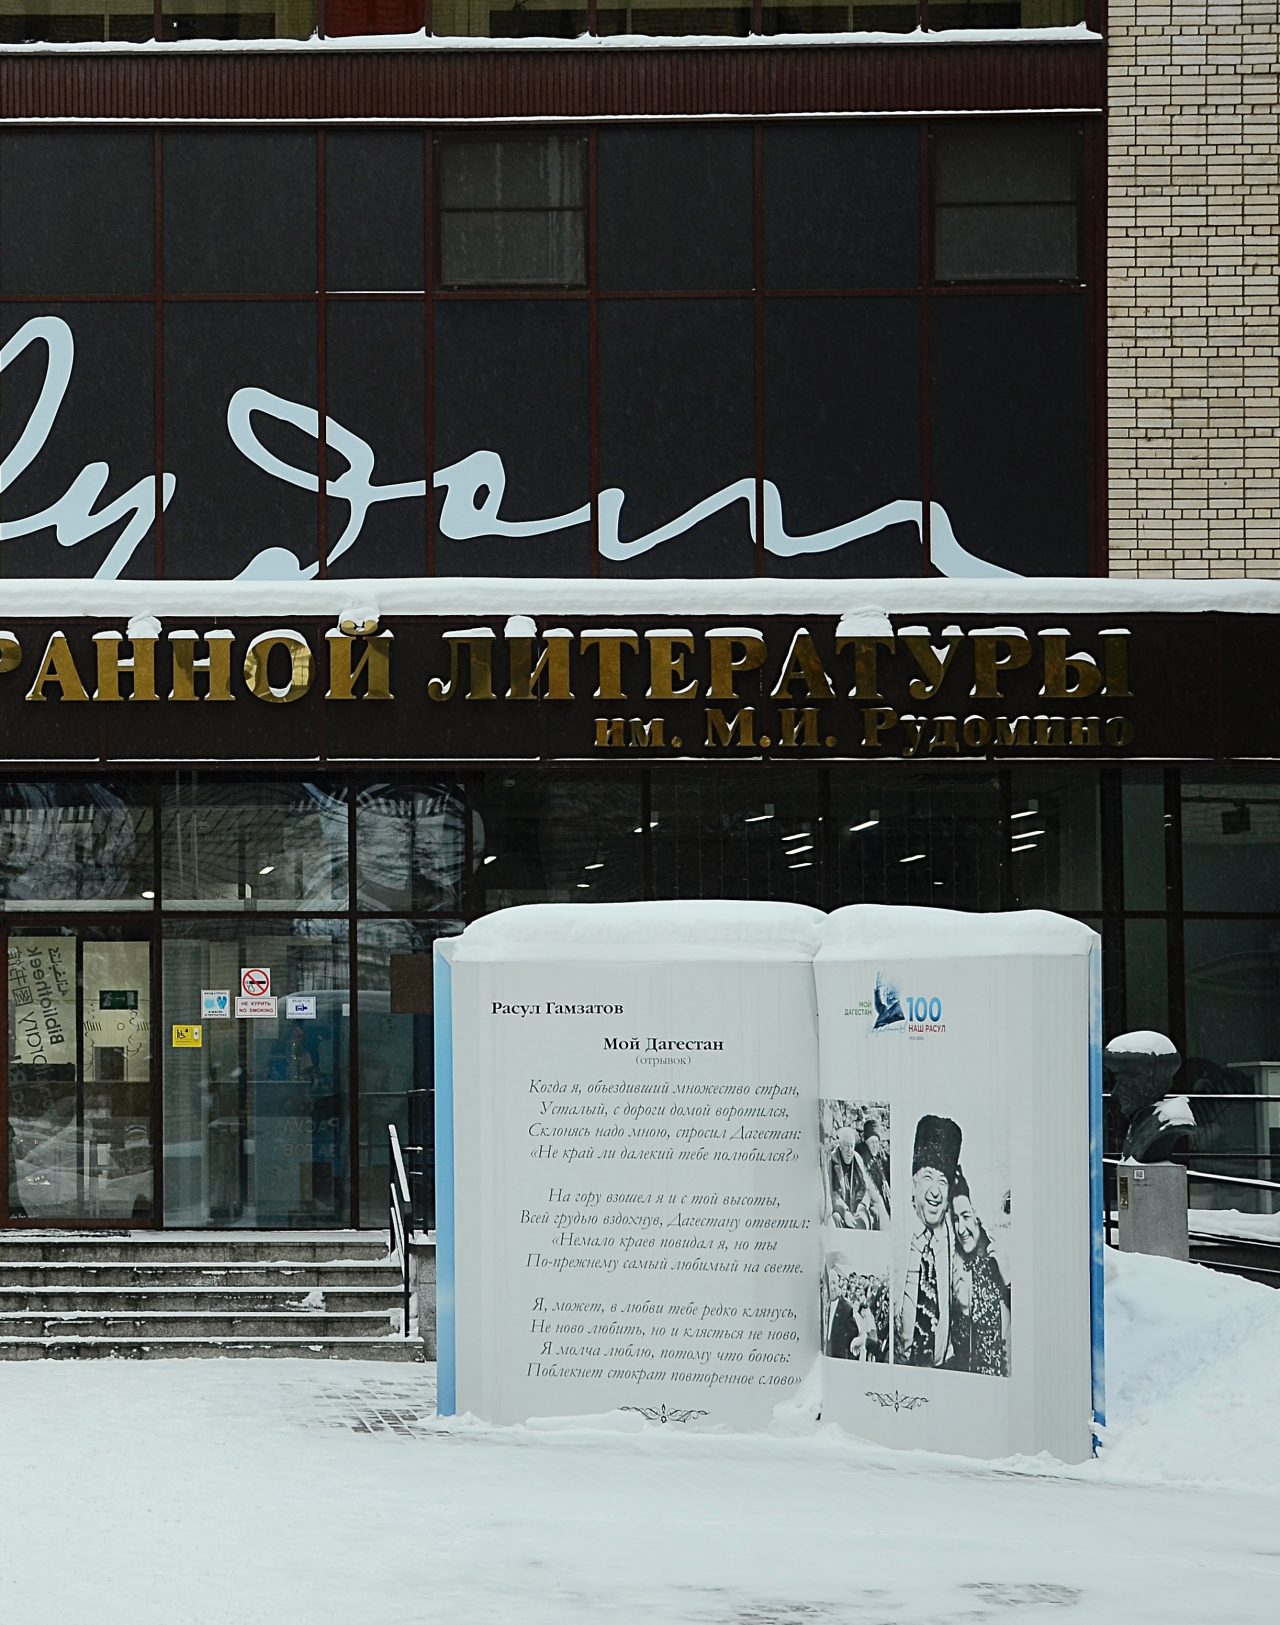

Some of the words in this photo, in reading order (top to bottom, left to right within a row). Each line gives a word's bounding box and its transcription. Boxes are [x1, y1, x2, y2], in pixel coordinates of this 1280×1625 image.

[428, 629, 1133, 701] ЛИТЕРАТУРЫ
[595, 717, 683, 748] им.
[703, 707, 838, 748] М.И.
[860, 708, 1136, 755] Рудомино
[491, 1002, 540, 1018] Расул
[546, 1002, 623, 1014] Гамзатов
[844, 1008, 872, 1016] ДАГЕСТАН
[906, 996, 942, 1022] 100
[908, 1025, 924, 1033] НАШ
[926, 1025, 946, 1033] РАСУЛ
[603, 1037, 640, 1050] Мой
[645, 1038, 724, 1053] Дагестан
[636, 1056, 691, 1067] (отрывок)
[528, 1079, 567, 1093] Когда
[570, 1083, 582, 1096] я,
[588, 1080, 669, 1094] объездивший
[673, 1085, 750, 1094] множество
[755, 1084, 799, 1099] стран,
[540, 1101, 607, 1117] Усталый,
[613, 1105, 621, 1116] с
[624, 1102, 665, 1120] дороги
[670, 1102, 710, 1116] домой
[716, 1106, 788, 1121] воротился,
[529, 1123, 590, 1136] Склонясь
[595, 1124, 624, 1137] надо
[628, 1128, 670, 1140] мною,
[676, 1127, 726, 1142] спросил
[730, 1125, 801, 1140] Дагестан:
[531, 1145, 558, 1158] «Не
[563, 1147, 594, 1163] край
[596, 1149, 617, 1160] ли
[621, 1146, 674, 1159] далекий
[678, 1147, 708, 1160] тебе
[713, 1148, 799, 1161] полюбился?»
[548, 1187, 571, 1203] На
[575, 1192, 601, 1207] гору
[607, 1194, 651, 1203] взошел
[654, 1193, 665, 1204] я
[667, 1194, 677, 1205] и
[680, 1194, 688, 1205] с
[691, 1193, 718, 1204] той
[723, 1196, 780, 1208] высоты,
[520, 1210, 549, 1223] Всей
[554, 1211, 598, 1228] грудью
[603, 1211, 662, 1229] вздохнув,
[667, 1213, 740, 1232] Дагестану
[745, 1219, 810, 1228] ответил:
[552, 1232, 614, 1246] «Немало
[620, 1236, 655, 1251] краев
[660, 1235, 713, 1249] повидал
[716, 1240, 731, 1253] я,
[733, 1240, 750, 1251] но
[753, 1241, 778, 1251] ты
[527, 1253, 618, 1273] По-прежнему
[623, 1258, 667, 1269] самый
[671, 1258, 738, 1272] любимый
[742, 1263, 760, 1273] на
[764, 1264, 803, 1273] свете.
[531, 1296, 548, 1314] Я,
[552, 1302, 604, 1314] может,
[610, 1303, 618, 1313] в
[621, 1300, 663, 1314] любви
[668, 1302, 698, 1315] тебе
[700, 1303, 737, 1320] редко
[742, 1308, 796, 1322] клянусь,
[530, 1318, 552, 1334] Не
[556, 1324, 584, 1333] ново
[587, 1321, 645, 1337] любить,
[650, 1326, 666, 1337] но
[670, 1327, 680, 1337] и
[684, 1328, 743, 1340] клясться
[747, 1330, 763, 1341] не
[768, 1331, 799, 1343] ново,
[540, 1340, 553, 1356] Я
[556, 1346, 600, 1356] молча
[604, 1344, 654, 1360] люблю,
[661, 1349, 711, 1363] потому
[717, 1352, 743, 1361] что
[748, 1349, 790, 1363] боюсь:
[527, 1363, 603, 1378] Поблекнет
[608, 1369, 666, 1384] стократ
[671, 1370, 754, 1387] повторенное
[759, 1376, 801, 1385] слово»
